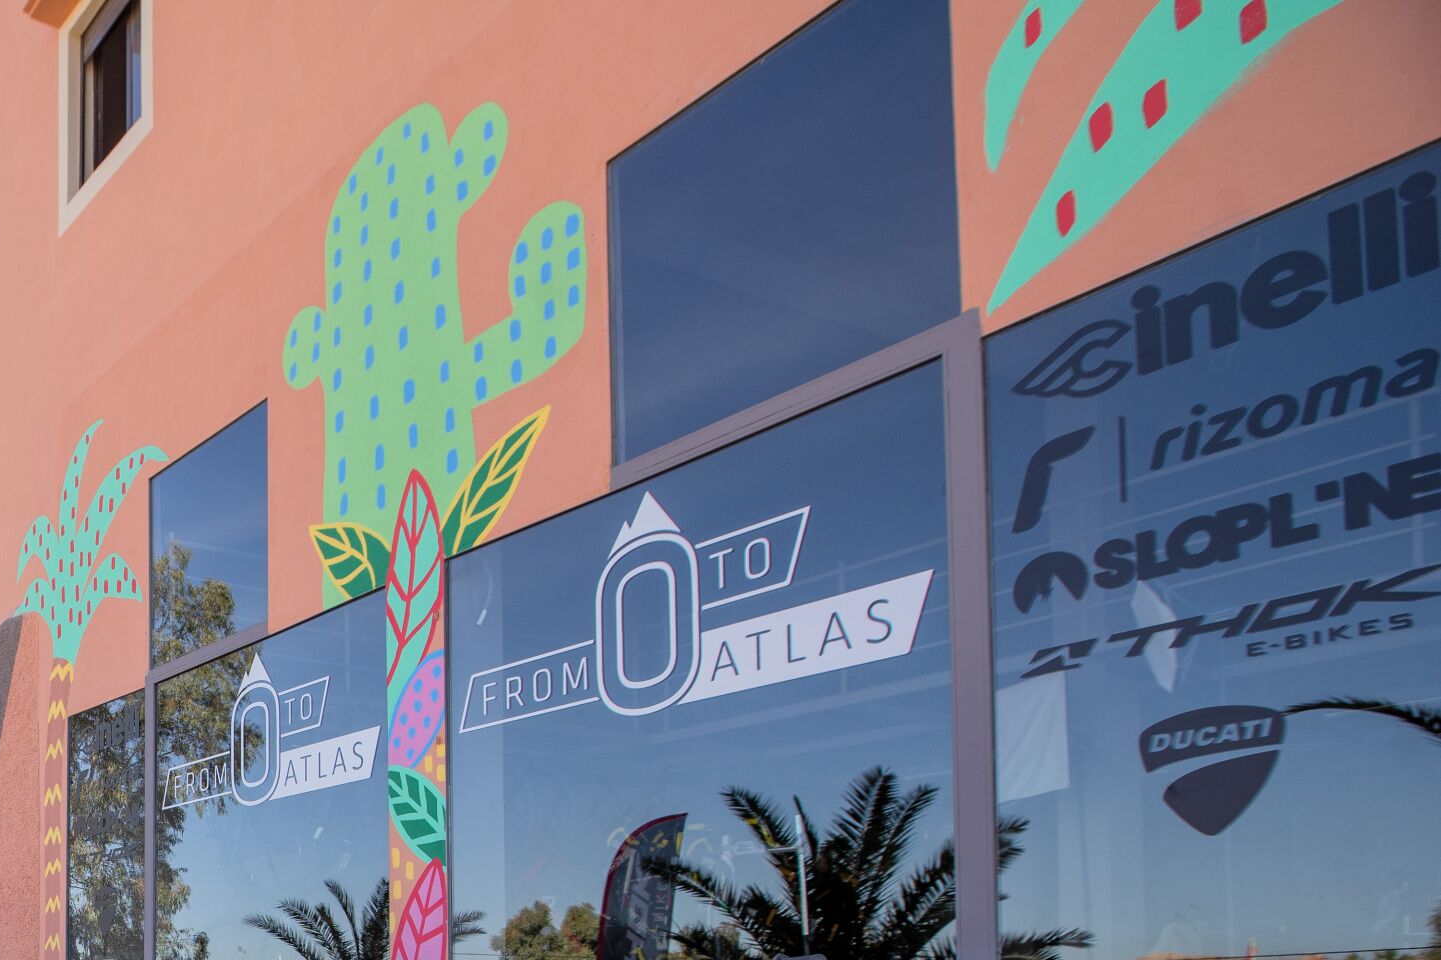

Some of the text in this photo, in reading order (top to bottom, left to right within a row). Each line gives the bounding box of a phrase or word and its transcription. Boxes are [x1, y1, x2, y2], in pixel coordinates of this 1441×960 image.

[1150, 347, 1441, 471] rizoma
[482, 656, 590, 716] FROM
[709, 536, 773, 590] TO
[710, 600, 894, 683] ATLAS
[1246, 612, 1415, 658] E-BIKES
[173, 762, 228, 799] FROM
[284, 693, 315, 725] TO
[284, 741, 365, 788] ATLAS
[1147, 716, 1274, 756] DUCATI
